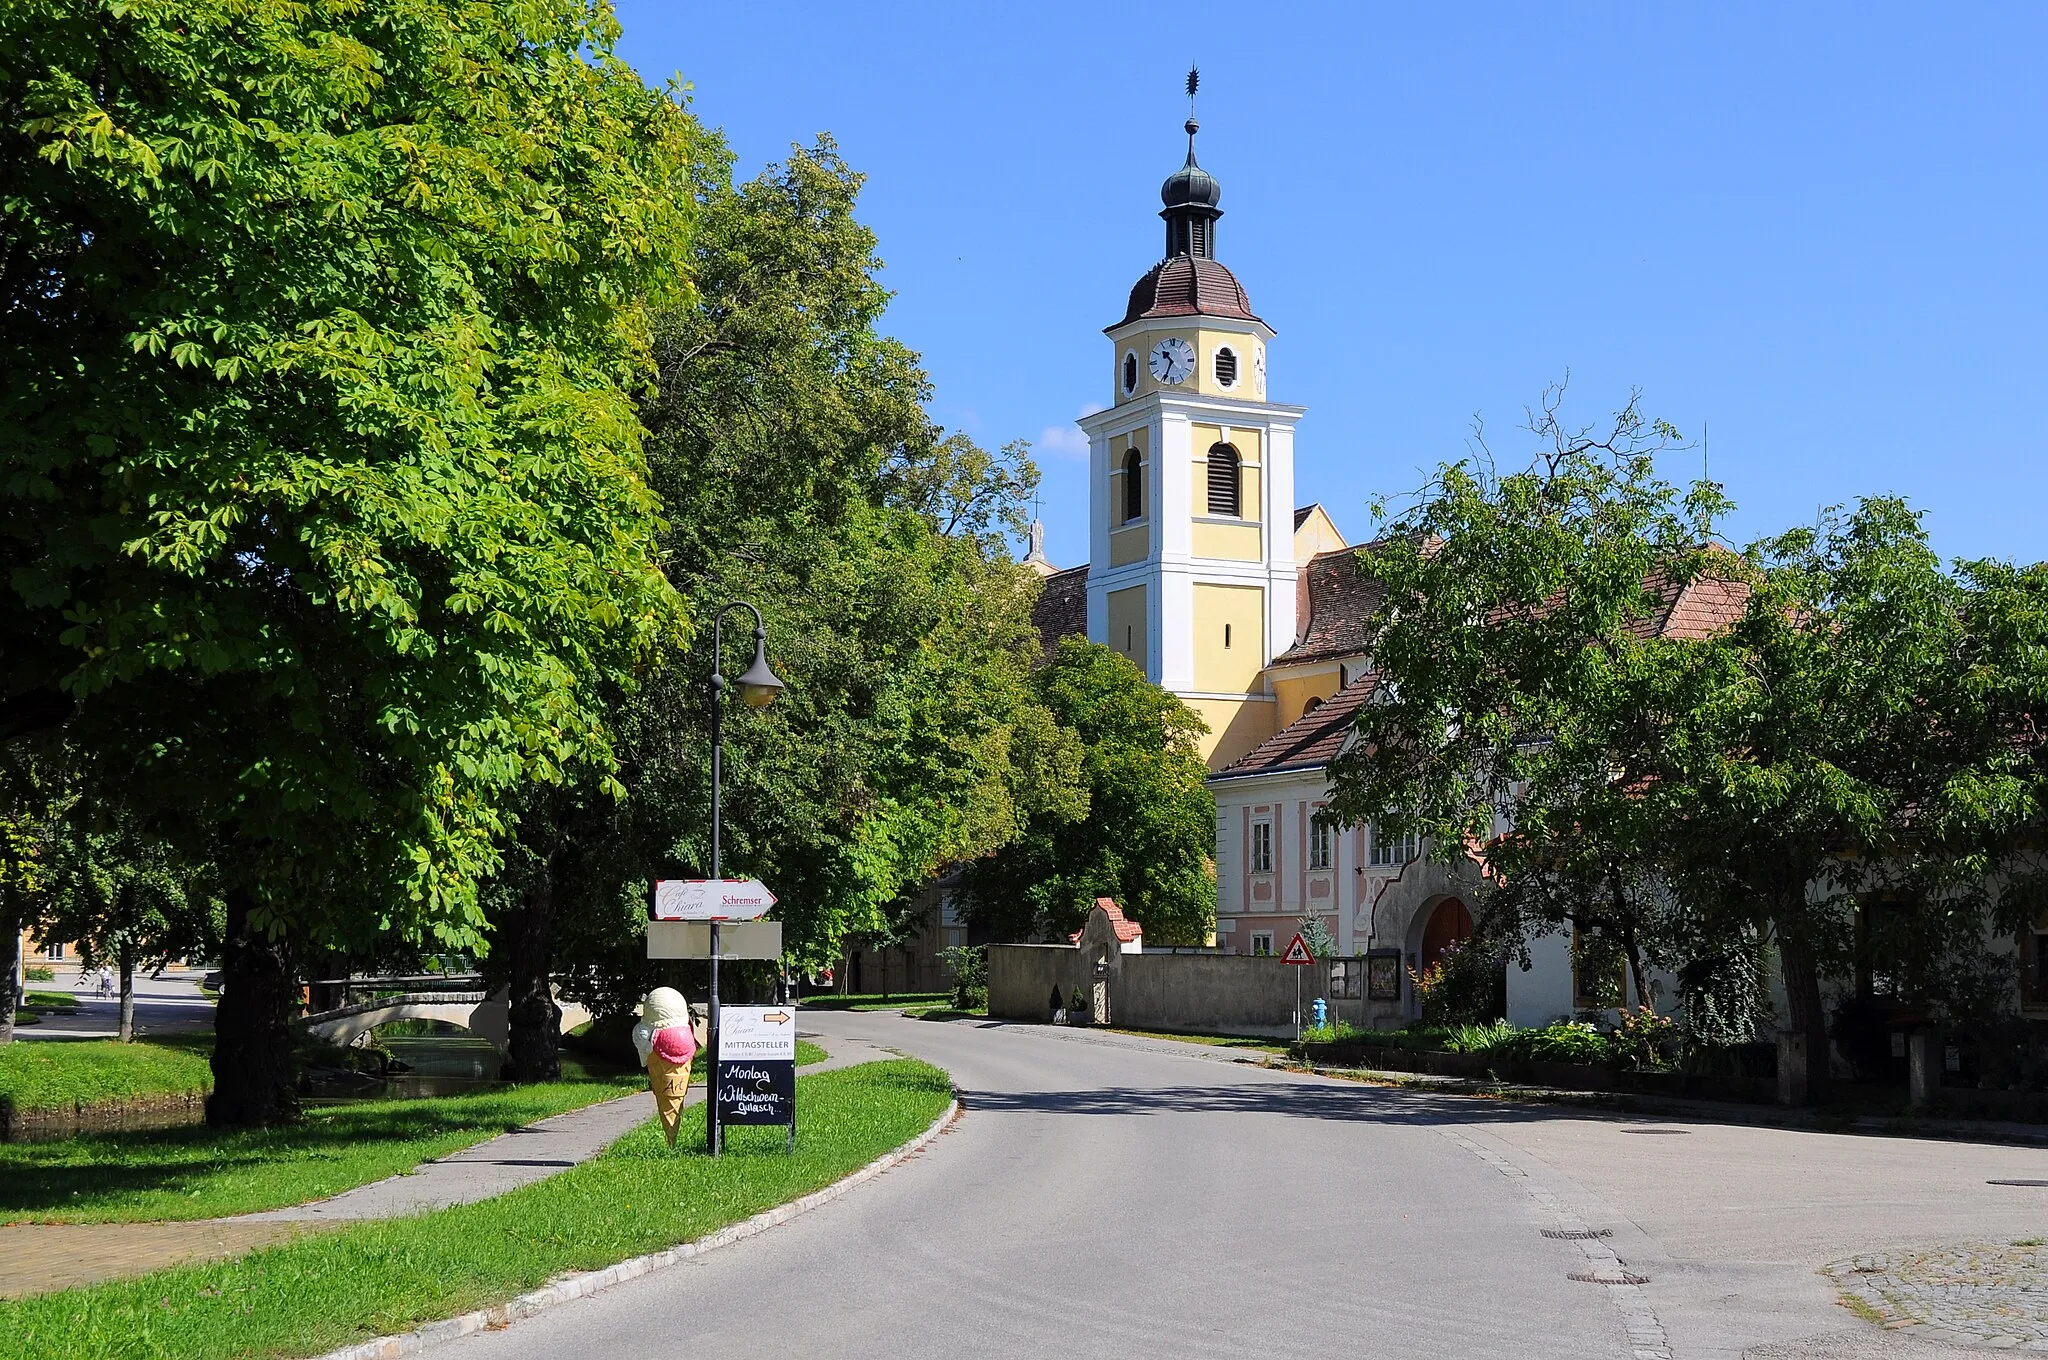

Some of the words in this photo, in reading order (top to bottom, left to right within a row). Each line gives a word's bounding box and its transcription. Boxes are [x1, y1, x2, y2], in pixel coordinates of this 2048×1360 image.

[722, 895, 762, 905] Schremser
[664, 899, 704, 915] Chiara
[724, 1041, 789, 1049] MITTAGSTELLER
